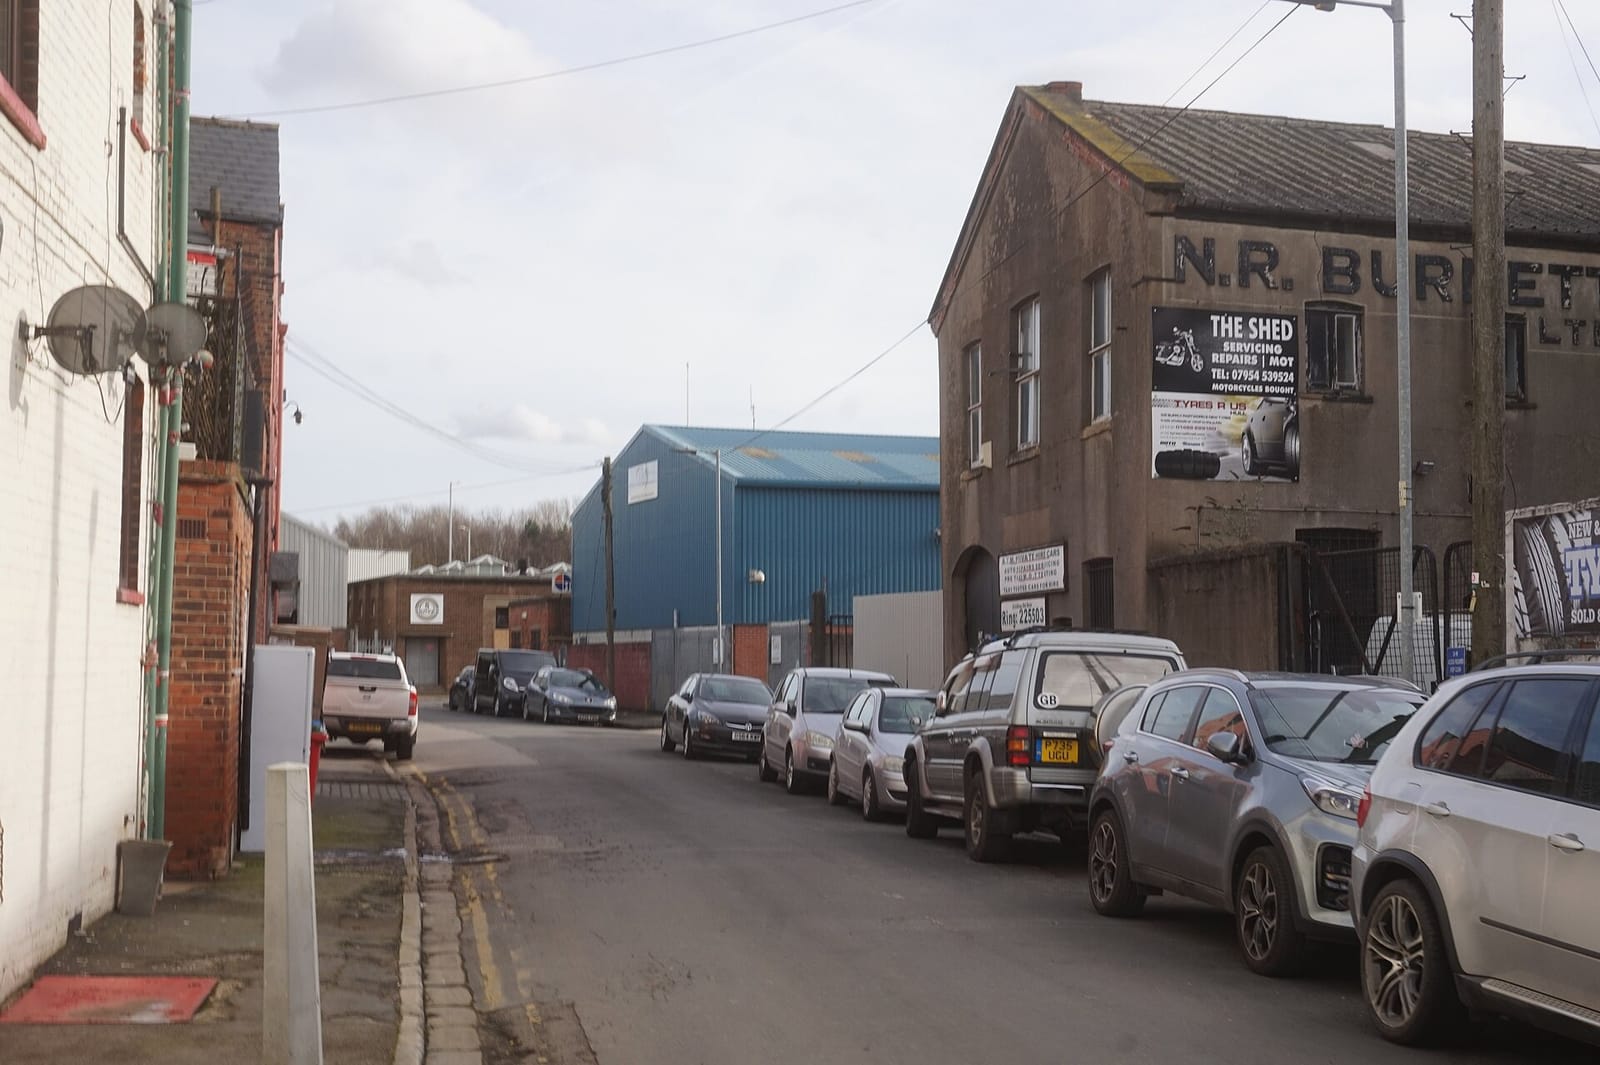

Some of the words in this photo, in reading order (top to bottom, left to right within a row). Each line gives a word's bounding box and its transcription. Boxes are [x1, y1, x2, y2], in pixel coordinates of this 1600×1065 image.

[1174, 234, 1294, 291] N.R.
[1322, 245, 1600, 309] BURET
[1210, 315, 1243, 339] THE
[1248, 317, 1294, 341] SHED
[1223, 341, 1283, 355] SERVICING
[1211, 353, 1258, 365] REPAIRS
[1269, 356, 1294, 367] MOT
[1211, 368, 1230, 380] TEL:
[1231, 369, 1260, 382] 07954
[1261, 371, 1294, 383] 539524
[1211, 383, 1263, 393] MOTORCYCLES
[1264, 385, 1294, 395] BOUGHT
[1174, 399, 1213, 409] TYRES
[1217, 401, 1226, 410] R
[1230, 402, 1247, 411] US
[1568, 520, 1593, 540] NEW
[1047, 548, 1060, 559] CARS
[1002, 610, 1018, 628] Ring:
[1019, 607, 1045, 624] 225503
[1571, 608, 1596, 624] SOLD
[1040, 694, 1057, 706] GB
[1045, 740, 1072, 751] P735
